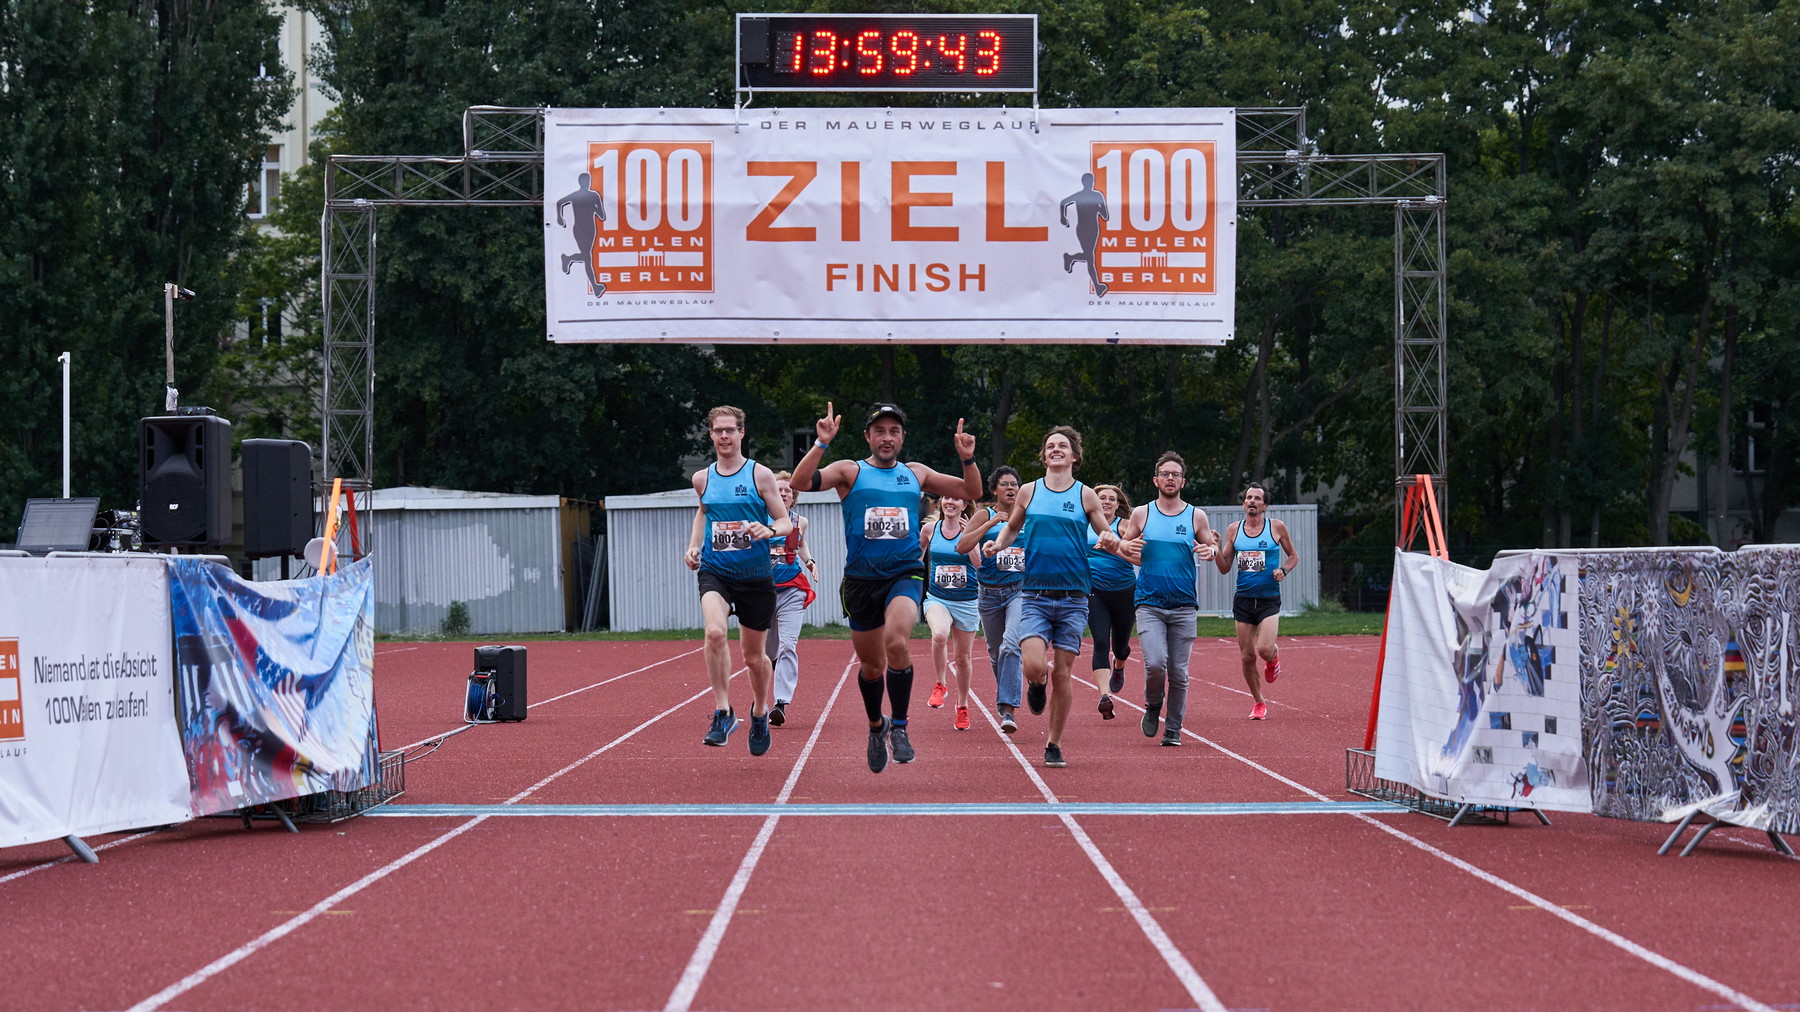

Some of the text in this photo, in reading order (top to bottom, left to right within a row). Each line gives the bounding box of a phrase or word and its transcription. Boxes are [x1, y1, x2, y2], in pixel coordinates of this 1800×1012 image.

[792, 30, 1001, 75] 13:59:43
[760, 121, 1037, 130] DER MAUERWEGLAUF
[593, 148, 704, 232] 100
[1096, 148, 1208, 232] 100
[746, 161, 1049, 242] ZIEL
[599, 236, 704, 247] MEILEN
[1102, 236, 1207, 248] MEILEN
[599, 272, 704, 282] BERLIN
[826, 263, 986, 292] FINISH
[1102, 273, 1207, 283] BERLIN
[867, 521, 906, 531] 1002-11
[713, 532, 750, 544] 1002-6
[936, 574, 966, 583] 1002-5
[34, 654, 86, 684] Niemand
[45, 696, 70, 725] 100
